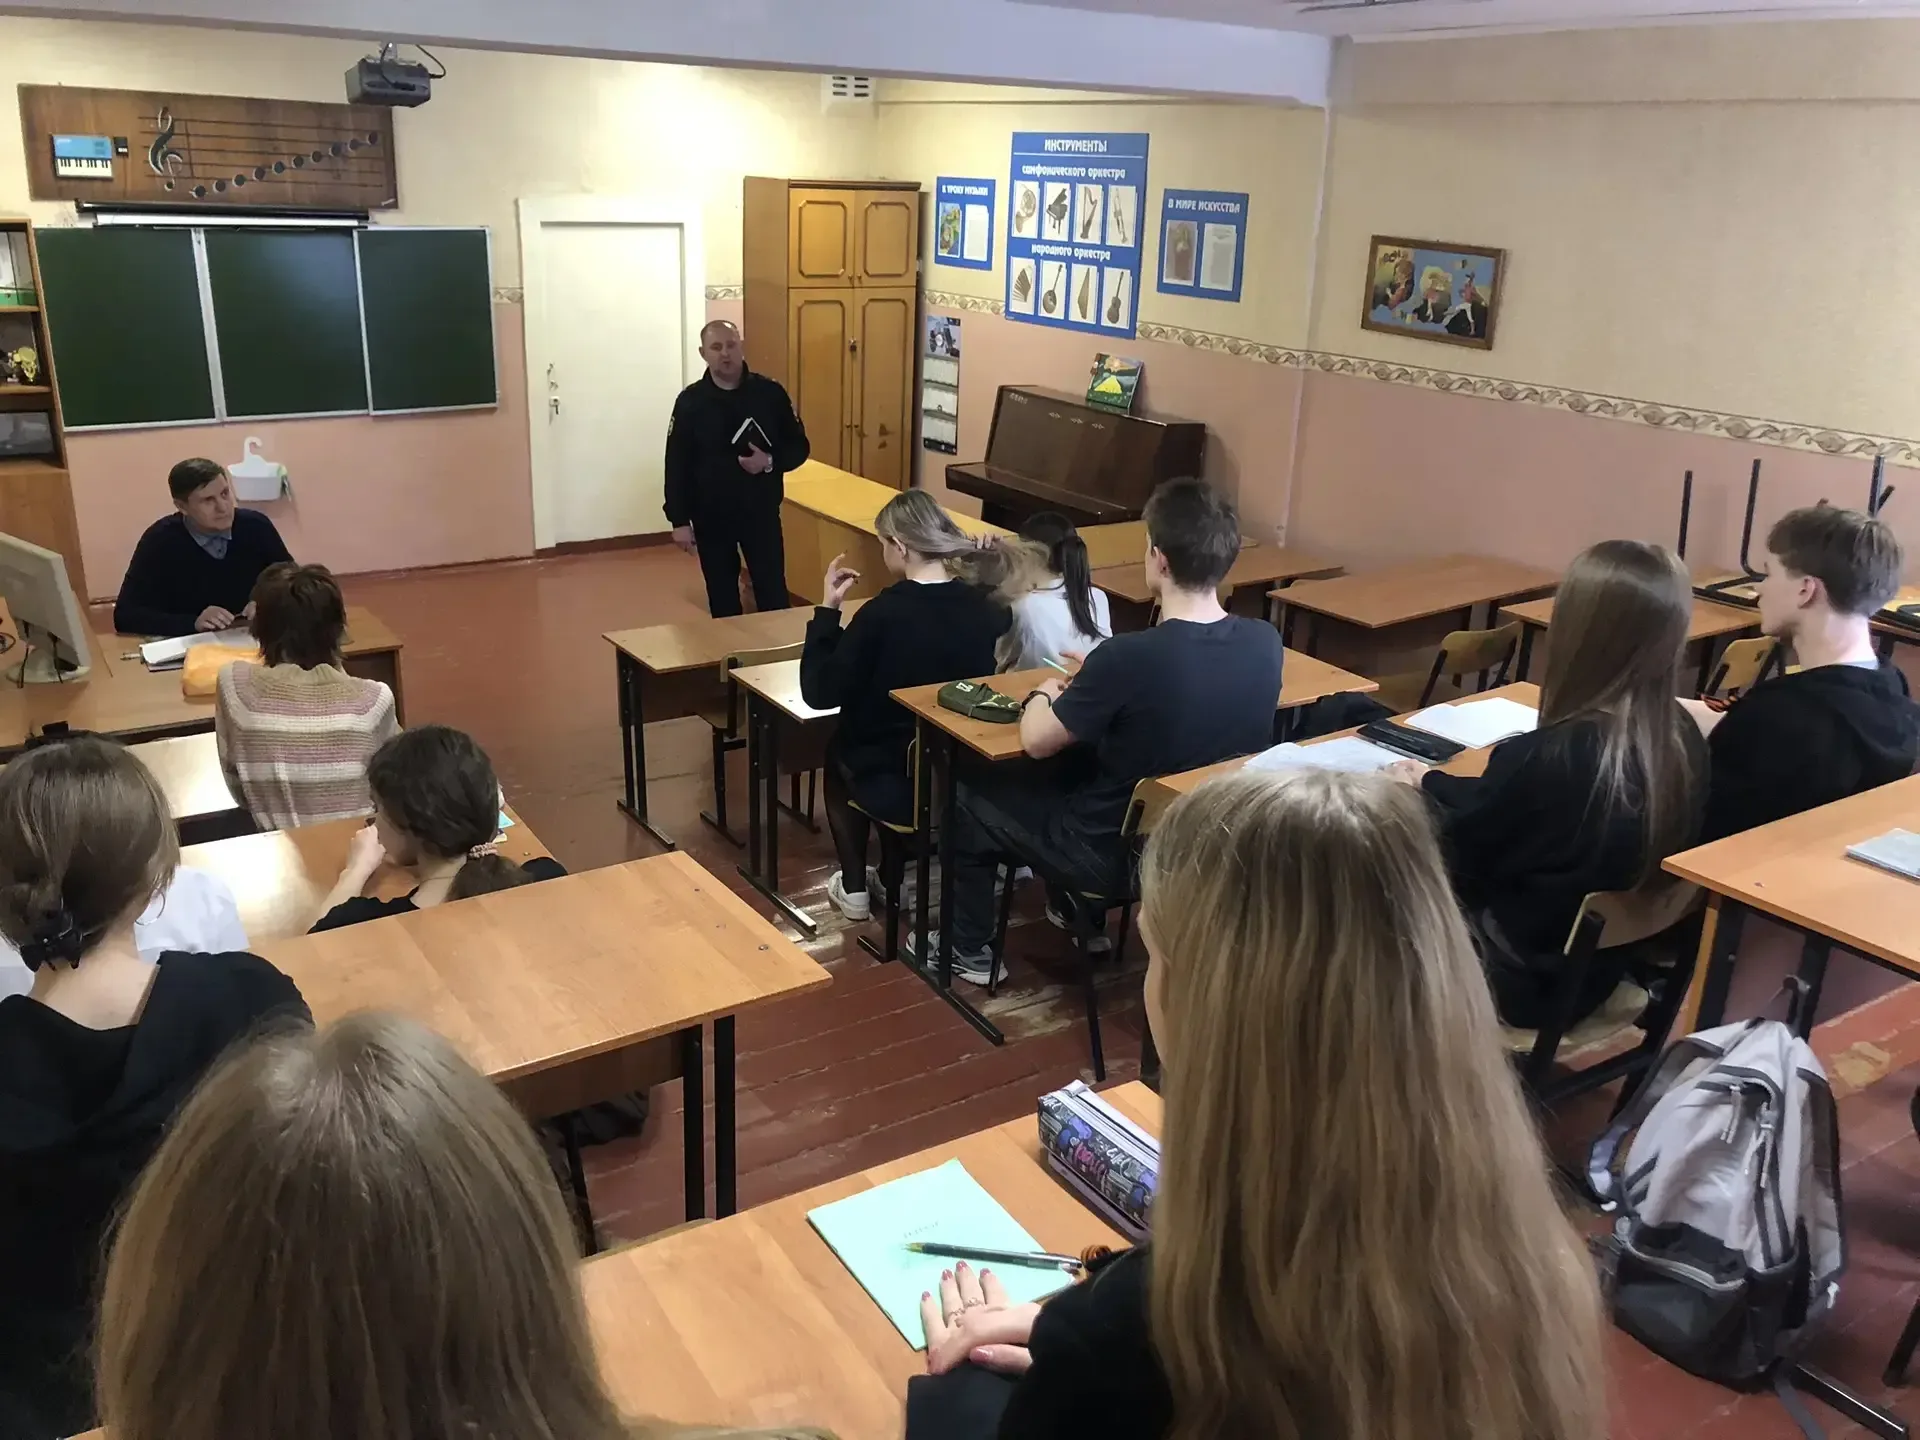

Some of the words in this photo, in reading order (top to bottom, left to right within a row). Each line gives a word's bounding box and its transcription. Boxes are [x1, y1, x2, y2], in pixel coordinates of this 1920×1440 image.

[1044, 139, 1107, 152] ИНСТРУМЕНТЫ
[1088, 167, 1126, 180] оркестра
[1168, 198, 1174, 208] В
[1175, 199, 1197, 210] МИРЕ
[1198, 200, 1240, 213] ИСКУССТВА
[1031, 244, 1072, 257] народного
[1074, 247, 1111, 262] оркестра
